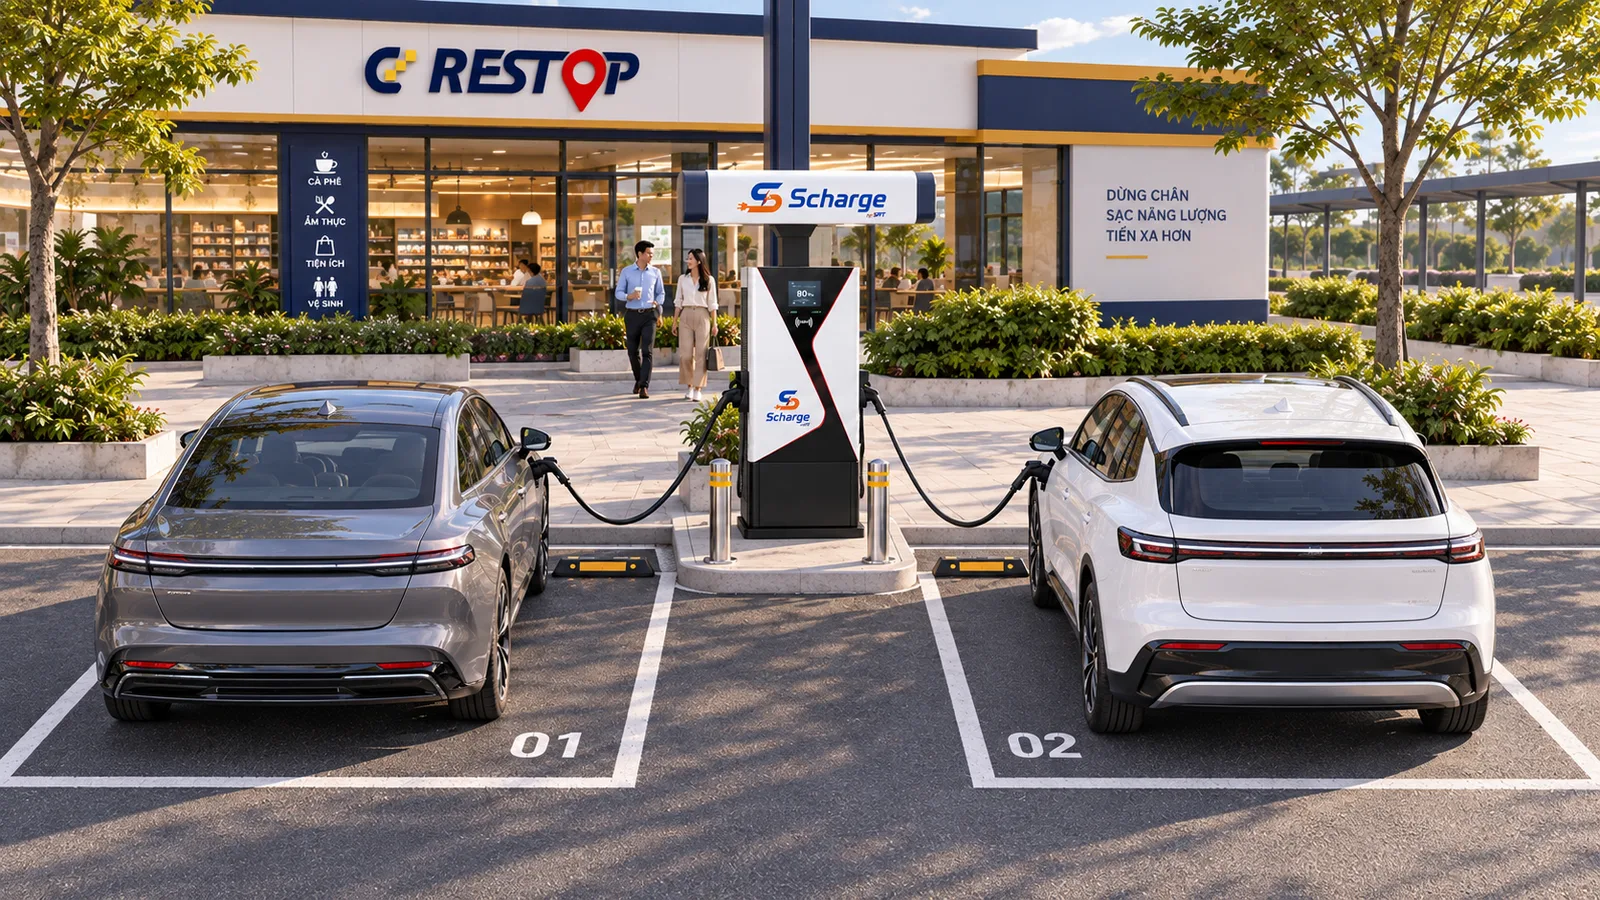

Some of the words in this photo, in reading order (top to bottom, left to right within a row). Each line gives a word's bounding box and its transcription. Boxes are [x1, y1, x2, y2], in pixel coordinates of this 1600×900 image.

[428, 47, 640, 113] RESTOP
[323, 176, 342, 186] PHÊ
[788, 188, 887, 213] Scharge
[1106, 186, 1147, 202] DỪNG
[1150, 186, 1189, 202] CHÂN
[321, 217, 346, 228] THỰC
[1106, 208, 1134, 224] SẠC
[1180, 207, 1227, 225] LƯỢNG
[1106, 225, 1137, 242] TIẾN
[1140, 229, 1158, 242] XA
[1161, 228, 1191, 242] HƠN
[305, 258, 327, 269] TIỆN
[328, 258, 345, 268] ÍCH
[796, 289, 808, 298] 80
[321, 300, 344, 308] SINH
[765, 412, 811, 424] Scharge
[510, 731, 582, 758] 01
[1007, 732, 1082, 758] 02
